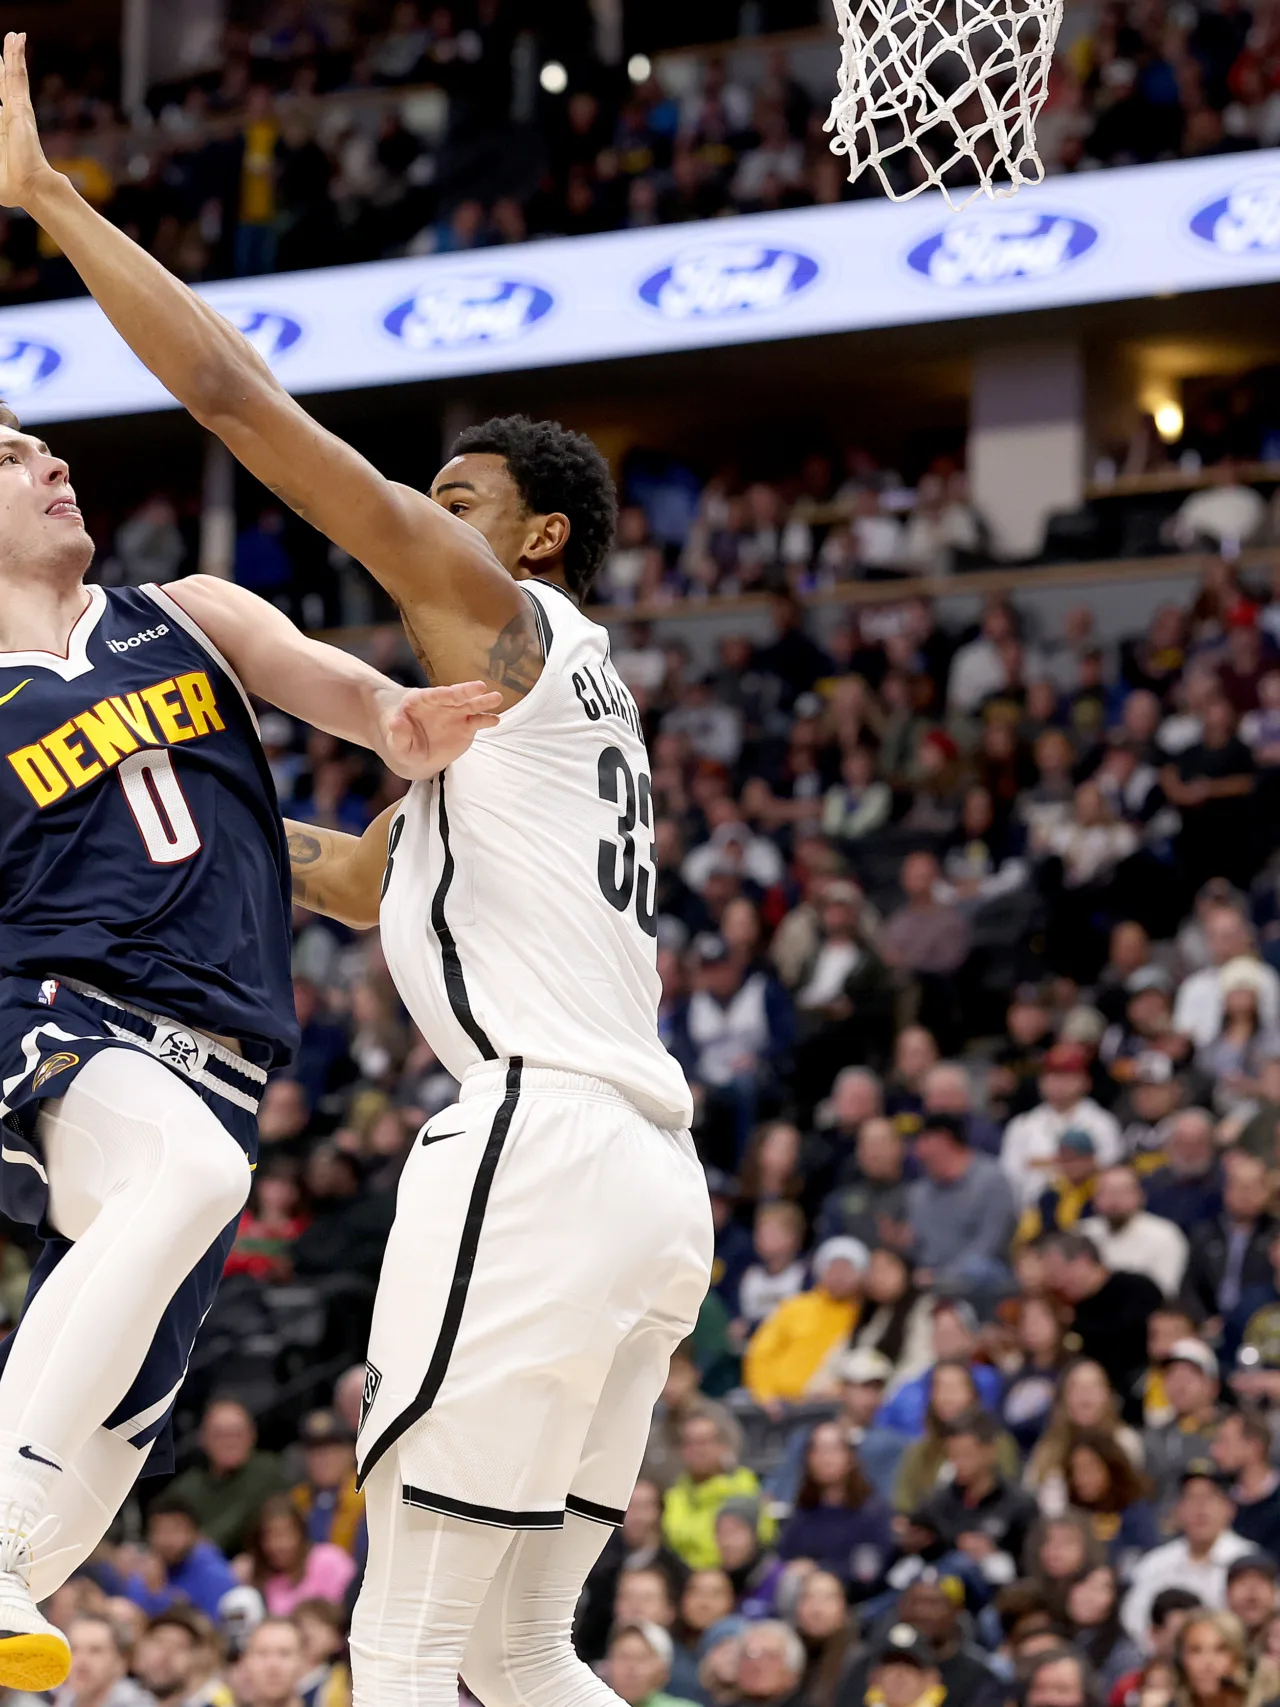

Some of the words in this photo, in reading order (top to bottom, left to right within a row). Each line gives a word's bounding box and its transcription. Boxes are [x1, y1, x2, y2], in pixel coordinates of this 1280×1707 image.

[656, 246, 800, 316] Ford
[925, 212, 1077, 288] Ford
[396, 281, 534, 348] Ford
[106, 622, 170, 654] ibotta
[6, 670, 225, 809] DENVER
[117, 748, 203, 864] 0
